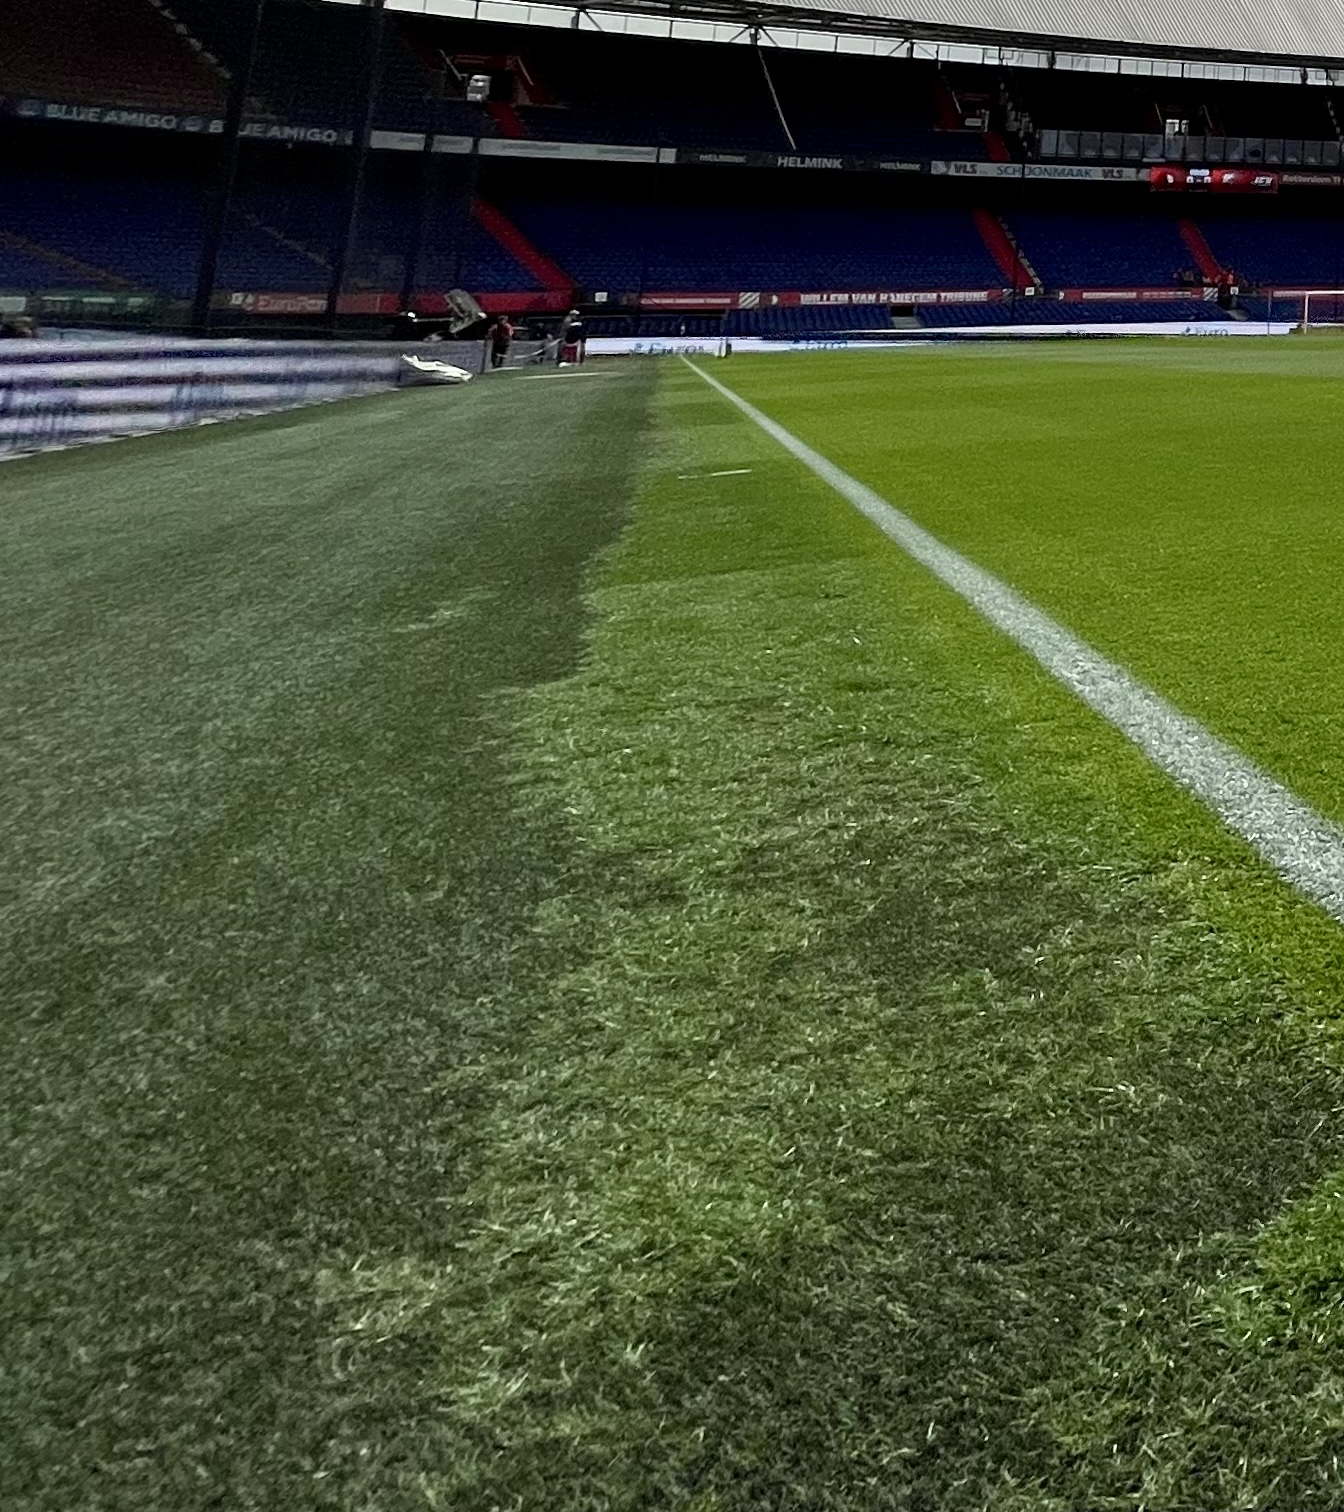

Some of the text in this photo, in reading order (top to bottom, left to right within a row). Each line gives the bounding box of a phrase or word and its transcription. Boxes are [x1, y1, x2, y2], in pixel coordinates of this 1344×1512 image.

[103, 109, 177, 130] AMIGO
[266, 124, 338, 143] AMIGO
[777, 155, 844, 170] HELMINK
[1282, 174, 1332, 184] Rotterdam
[851, 292, 876, 304] VAN
